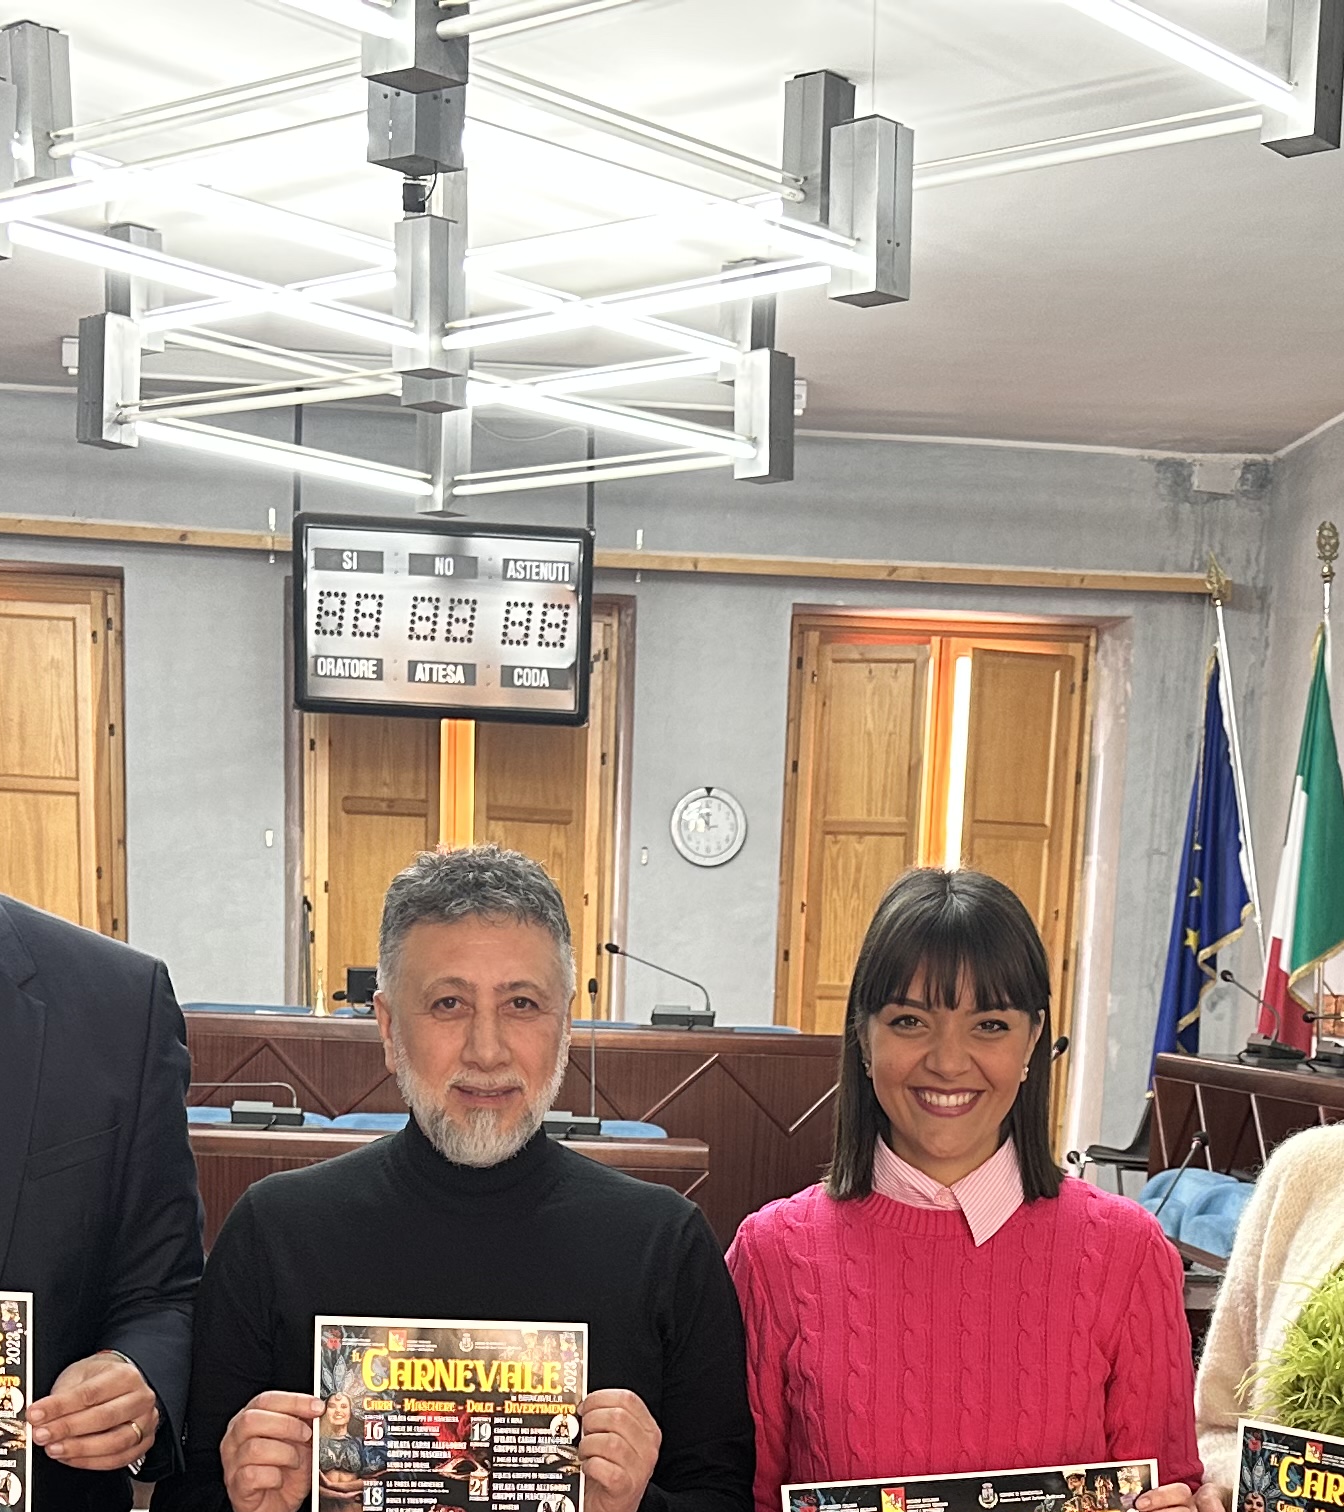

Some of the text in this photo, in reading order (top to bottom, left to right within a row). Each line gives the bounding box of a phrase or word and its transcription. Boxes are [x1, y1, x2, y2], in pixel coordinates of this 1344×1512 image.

[342, 552, 358, 570] SI
[435, 557, 454, 575] NO
[506, 561, 569, 582] ASTENUTI
[317, 657, 378, 679] ORATORE
[414, 663, 465, 683] ATTESA
[513, 667, 549, 687] CODA
[362, 1348, 564, 1394] CARNEVALE
